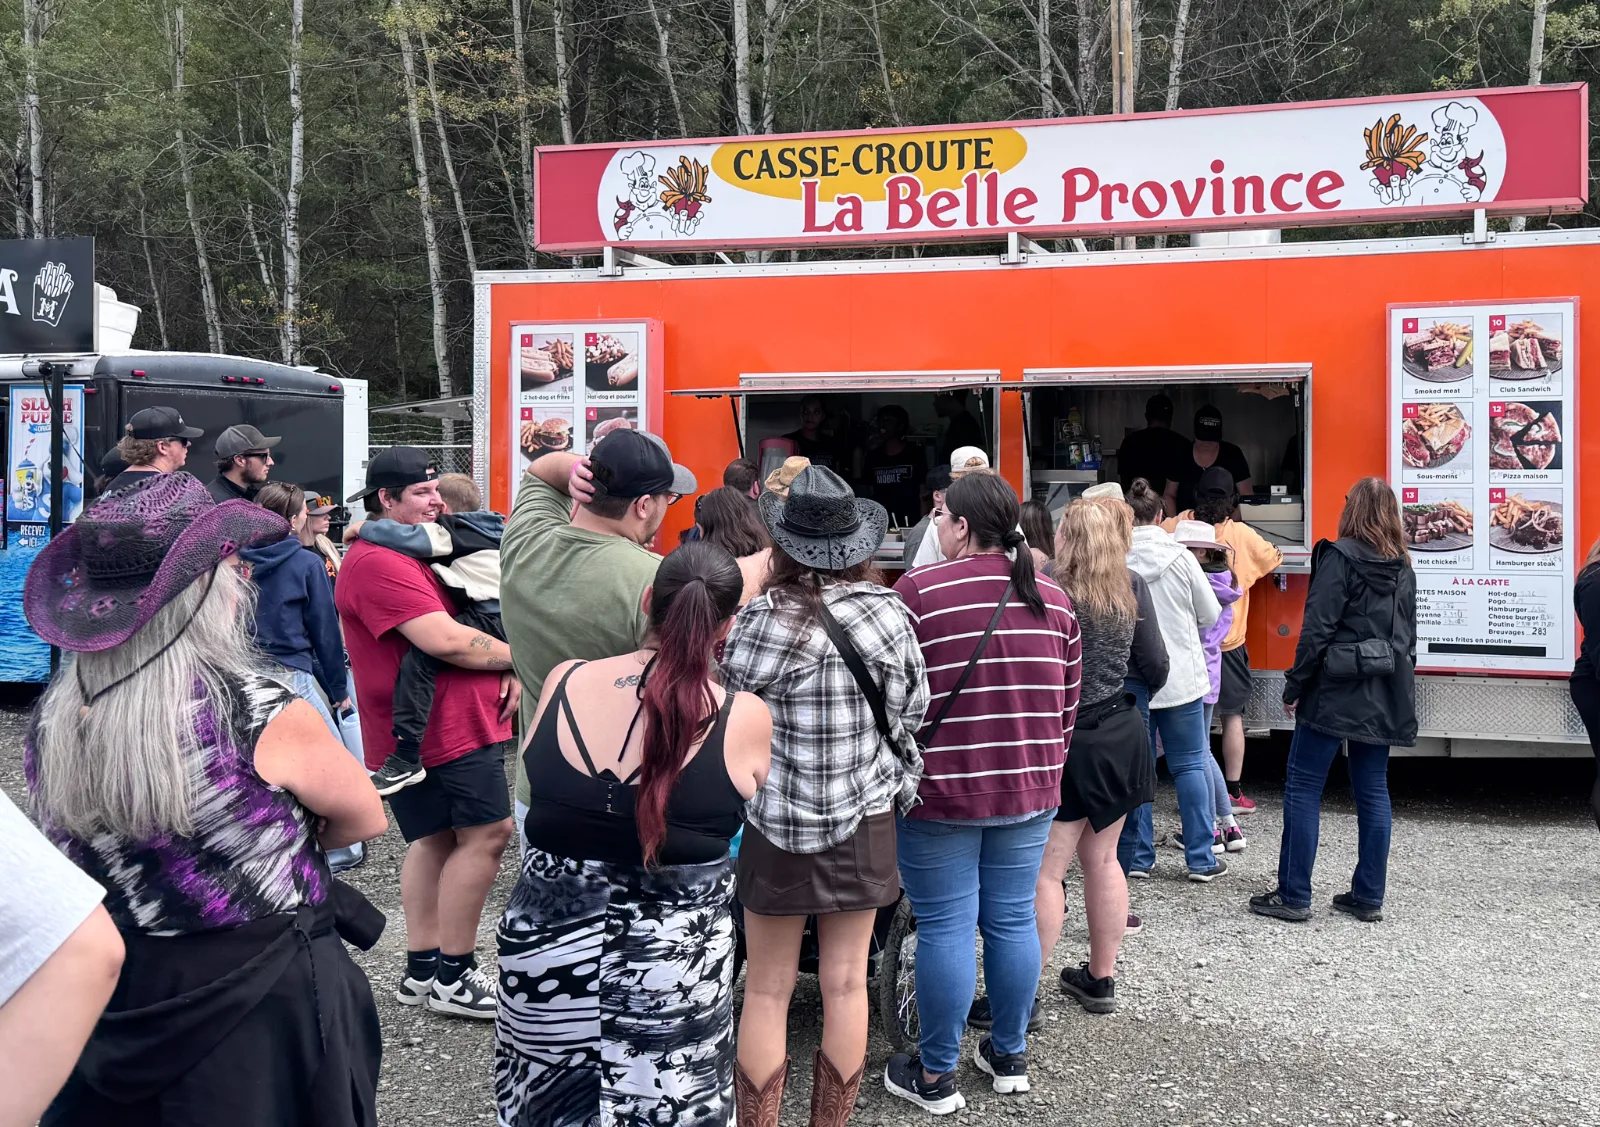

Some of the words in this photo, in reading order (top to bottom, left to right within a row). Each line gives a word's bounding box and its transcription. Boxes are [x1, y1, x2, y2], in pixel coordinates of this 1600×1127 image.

[733, 137, 994, 180] CASSE-CROUTE
[802, 181, 864, 233] La
[885, 171, 1038, 230] Belle
[1061, 159, 1345, 222] Province
[21, 397, 72, 411] SLUH
[21, 412, 73, 424] PUPE
[20, 524, 46, 536] RECEVEZ
[1496, 560, 1535, 568] Hamburger
[1452, 576, 1459, 585] À
[1462, 578, 1474, 586] LA
[1477, 578, 1510, 586] CARTE
[1488, 628, 1525, 636] Breuvages
